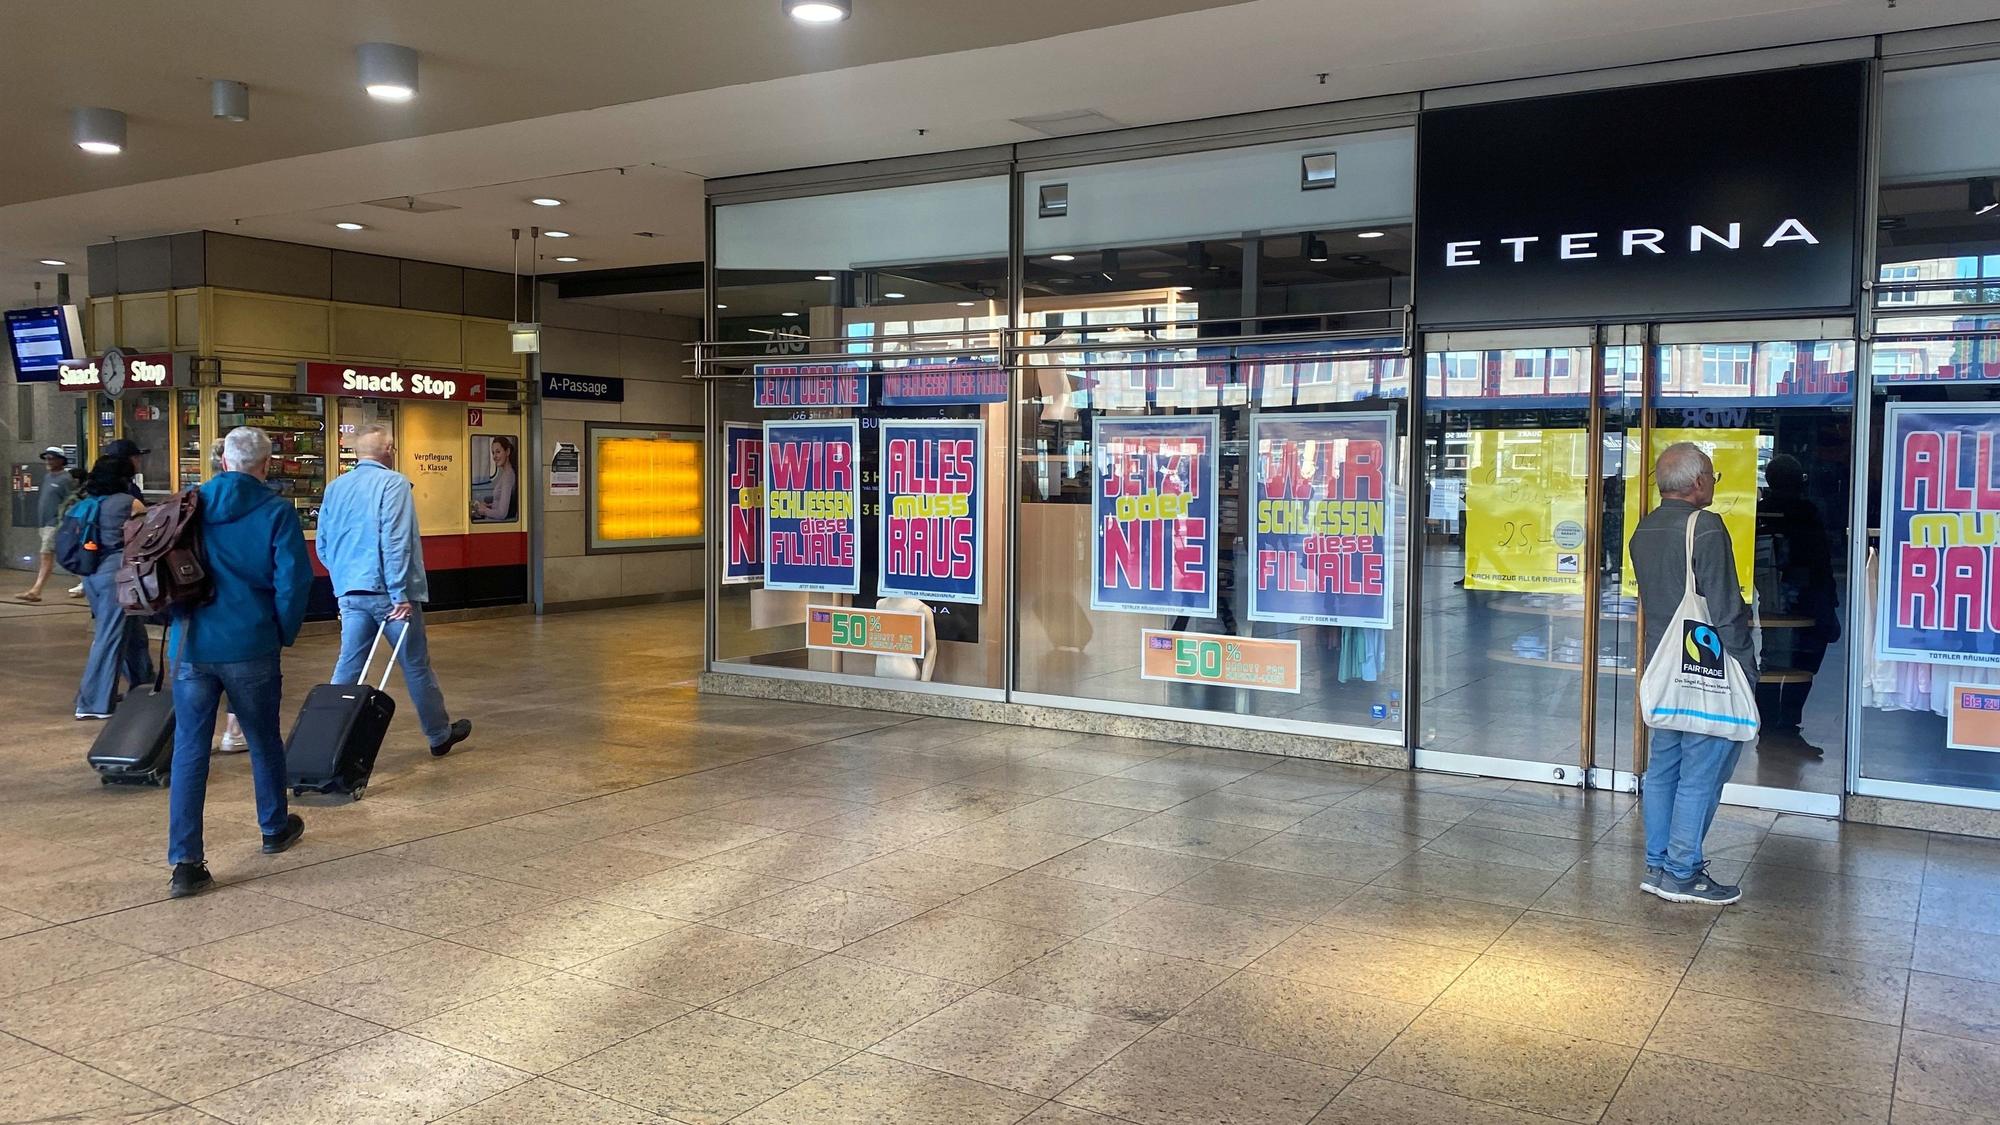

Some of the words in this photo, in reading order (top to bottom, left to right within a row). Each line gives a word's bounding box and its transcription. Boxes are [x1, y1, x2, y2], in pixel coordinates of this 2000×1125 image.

[1446, 218, 1819, 267] ETERNA
[60, 363, 100, 385] Snack
[131, 361, 166, 385] Stop
[343, 369, 404, 392] Snack
[411, 373, 456, 399] Stop
[549, 377, 608, 396] A-Passage
[761, 367, 797, 405] JETZT
[800, 366, 834, 405] ODER
[837, 365, 859, 404] NIE
[414, 453, 453, 463] Verpflegung
[769, 441, 852, 490] WIR
[889, 438, 974, 497] ALLES
[1103, 436, 1206, 499] JETZT
[1259, 439, 1384, 500] WIR
[1900, 431, 2000, 511] ALL
[770, 490, 853, 519] SCHLIESSEN
[1116, 487, 1194, 523] oder
[1258, 500, 1385, 537] SCHLIESSEN
[800, 518, 848, 535] diese
[1302, 532, 1374, 554] diese
[771, 531, 854, 568] FILIALE
[888, 515, 974, 580] RAUS
[1103, 514, 1206, 594] NIE
[1258, 550, 1384, 596] FILIALE
[832, 612, 867, 647] 50
[869, 615, 882, 632] %
[1175, 638, 1222, 679] 50
[1225, 642, 1242, 662] %
[1683, 663, 1723, 677] FAIRTRADE
[1929, 652, 1961, 660] TOTALER
[1962, 693, 1982, 709] Bis
